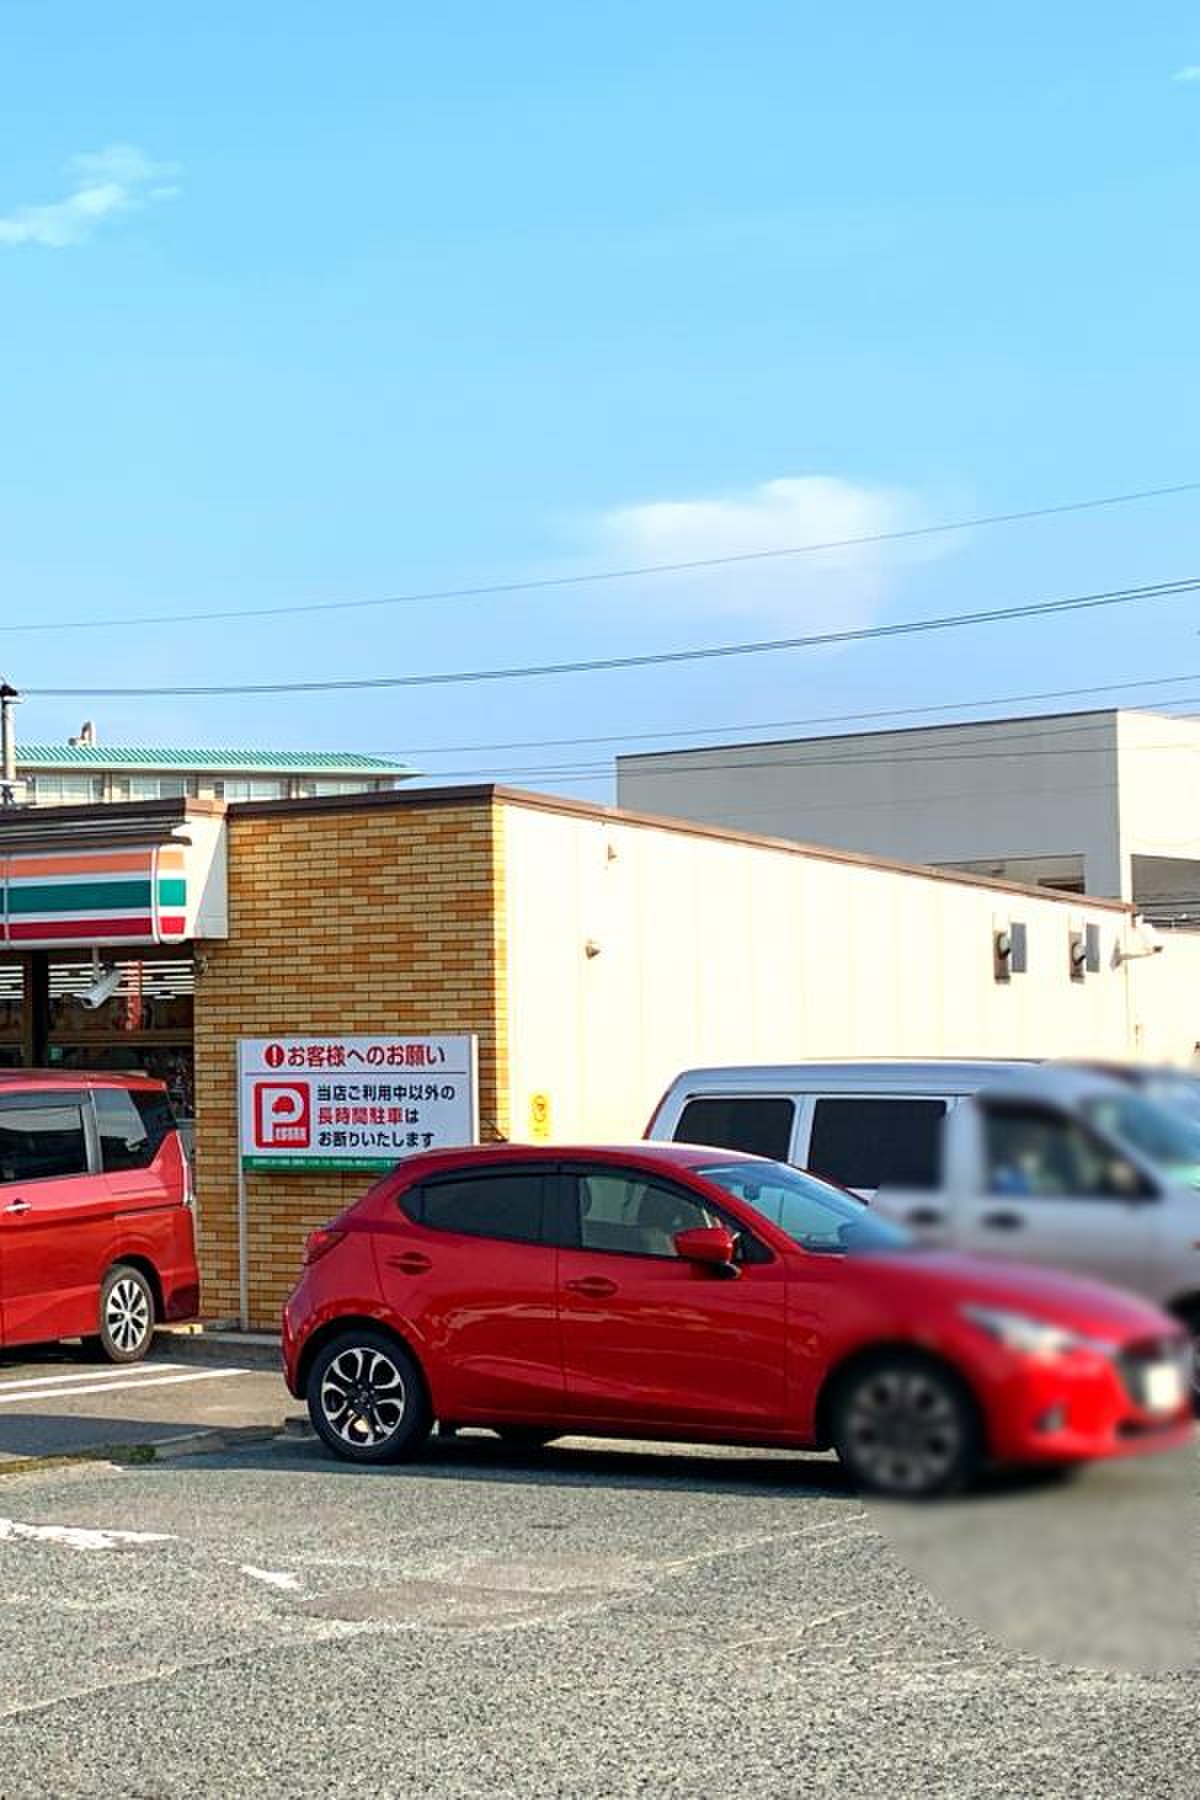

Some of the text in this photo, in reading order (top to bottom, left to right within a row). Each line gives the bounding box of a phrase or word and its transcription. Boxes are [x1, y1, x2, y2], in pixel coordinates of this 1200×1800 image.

[287, 1045, 445, 1067] お客様へのお願い
[316, 1084, 455, 1101] 当店ご利用中以外の
[318, 1107, 419, 1125] 長時間駐車は
[318, 1131, 434, 1148] お断りいたします
